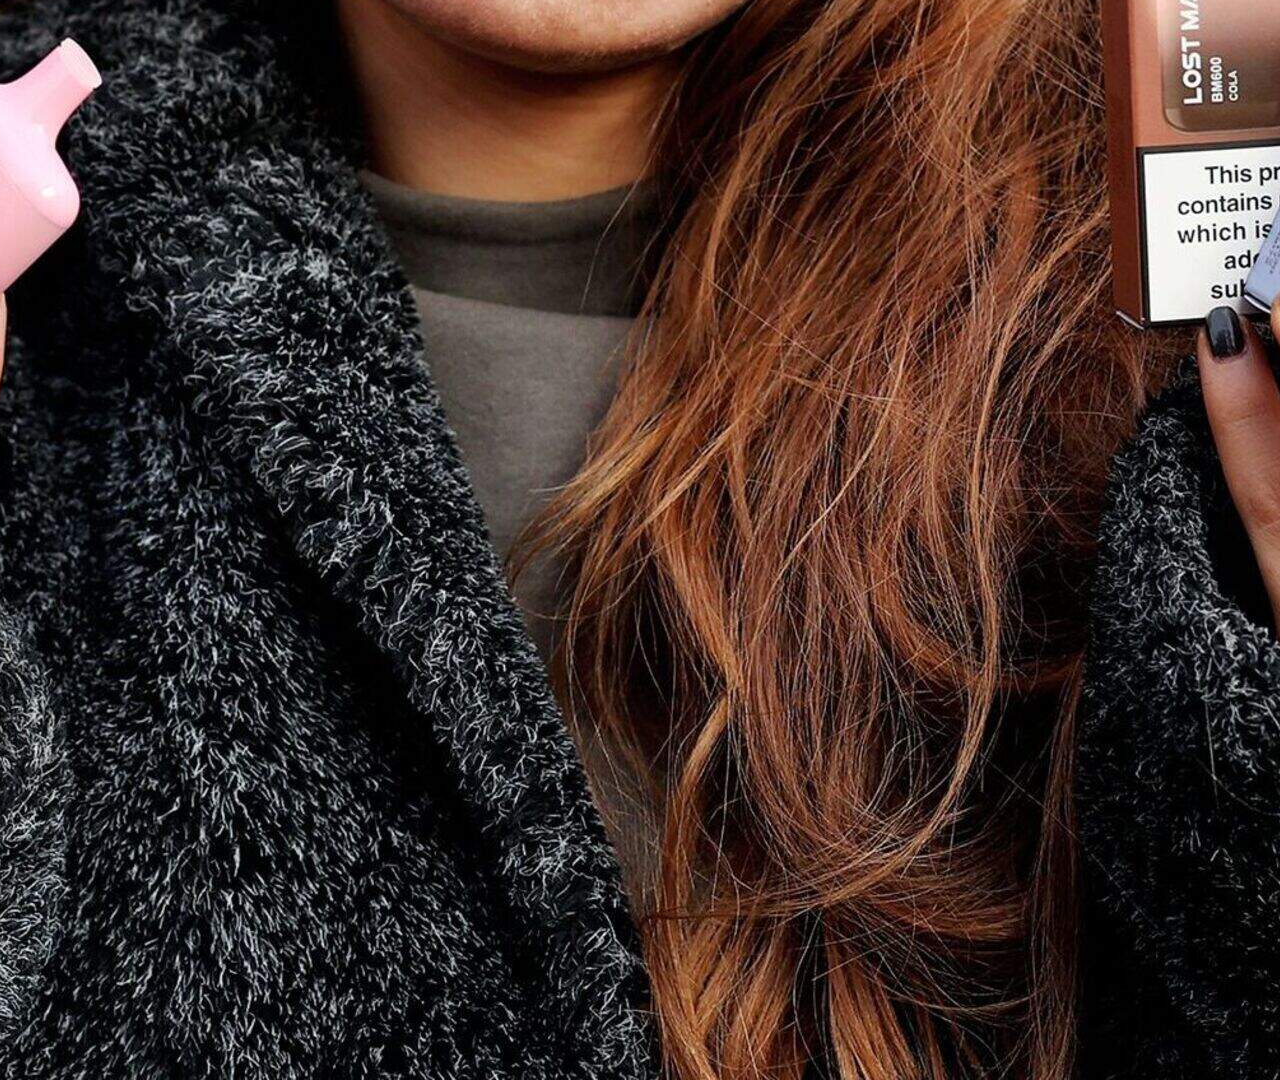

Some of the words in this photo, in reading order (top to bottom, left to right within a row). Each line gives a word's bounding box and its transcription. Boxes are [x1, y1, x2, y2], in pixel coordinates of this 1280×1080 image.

[1180, 36, 1204, 106] LOST
[1209, 56, 1224, 103] BM600
[1228, 70, 1239, 102] COLA
[1204, 164, 1253, 185] This
[1177, 192, 1274, 216] contains
[1177, 222, 1247, 244] which
[1255, 220, 1273, 239] is
